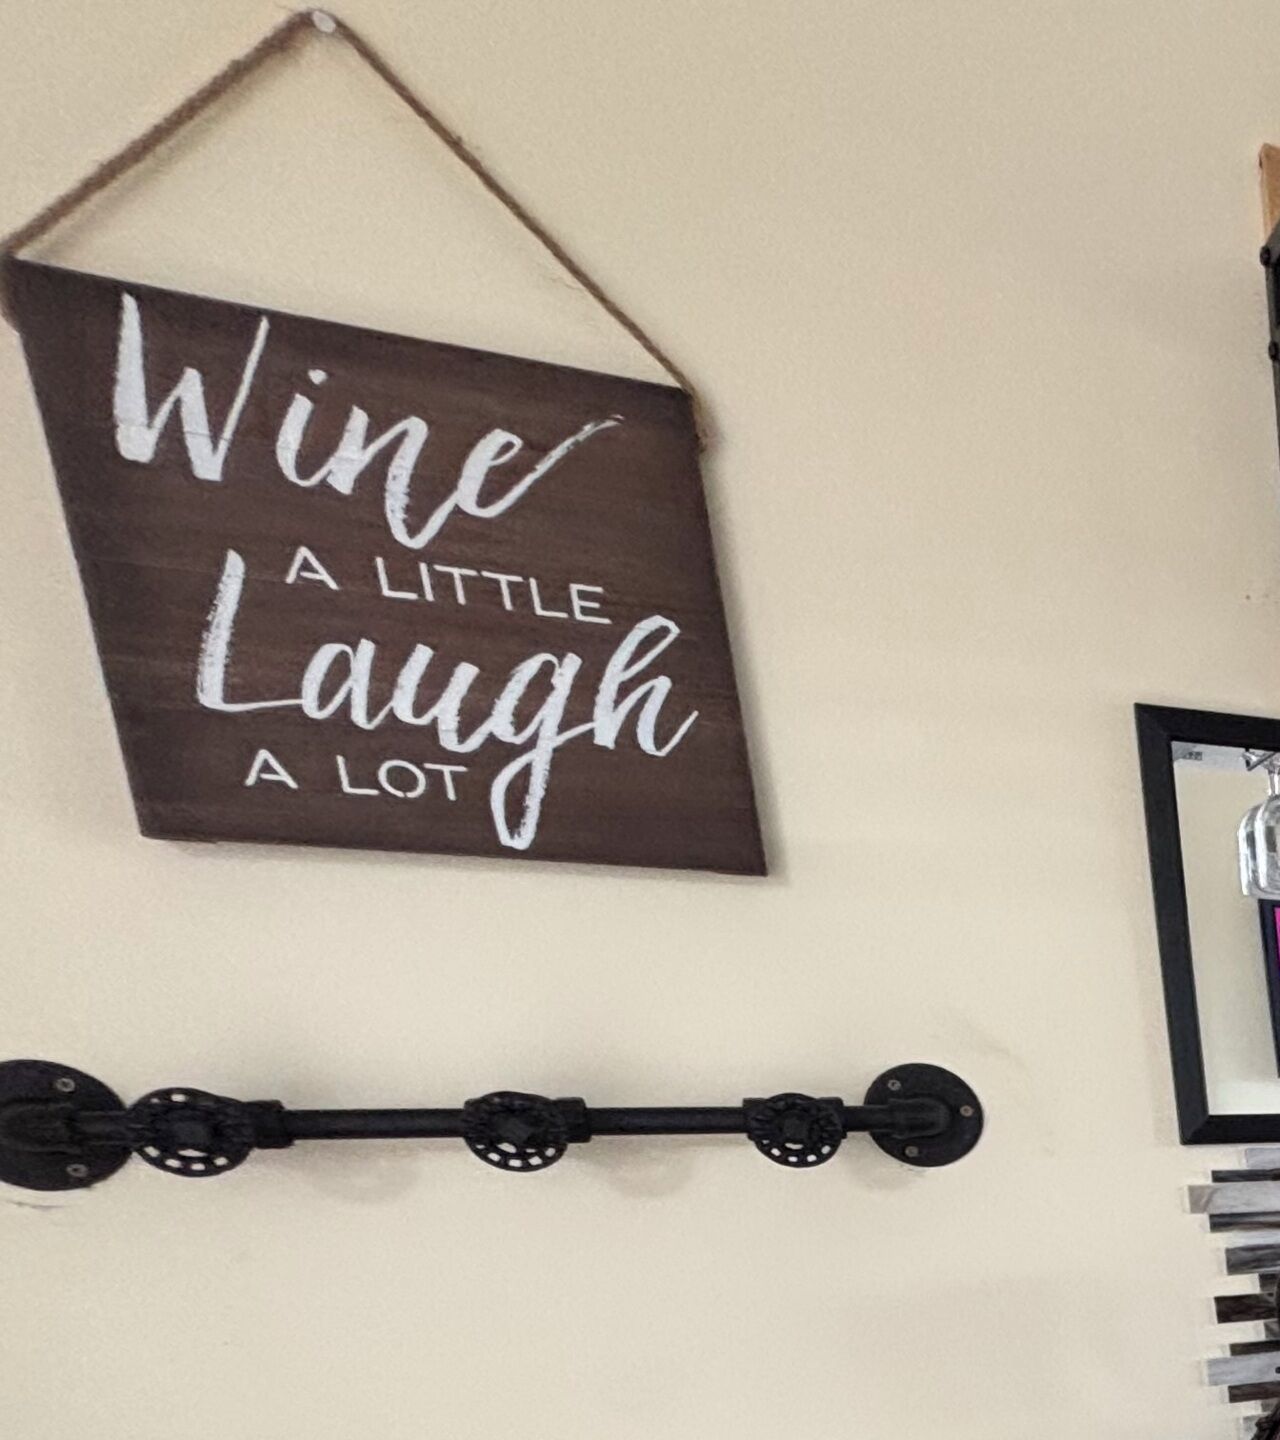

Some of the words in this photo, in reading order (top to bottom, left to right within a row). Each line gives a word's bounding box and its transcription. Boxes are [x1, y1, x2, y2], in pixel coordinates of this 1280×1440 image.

[112, 292, 624, 550] Wine
[285, 545, 340, 591] A
[375, 556, 612, 625] LITTLE
[196, 547, 699, 851] Laugh
[245, 748, 299, 790] A
[336, 754, 468, 801] LOT
